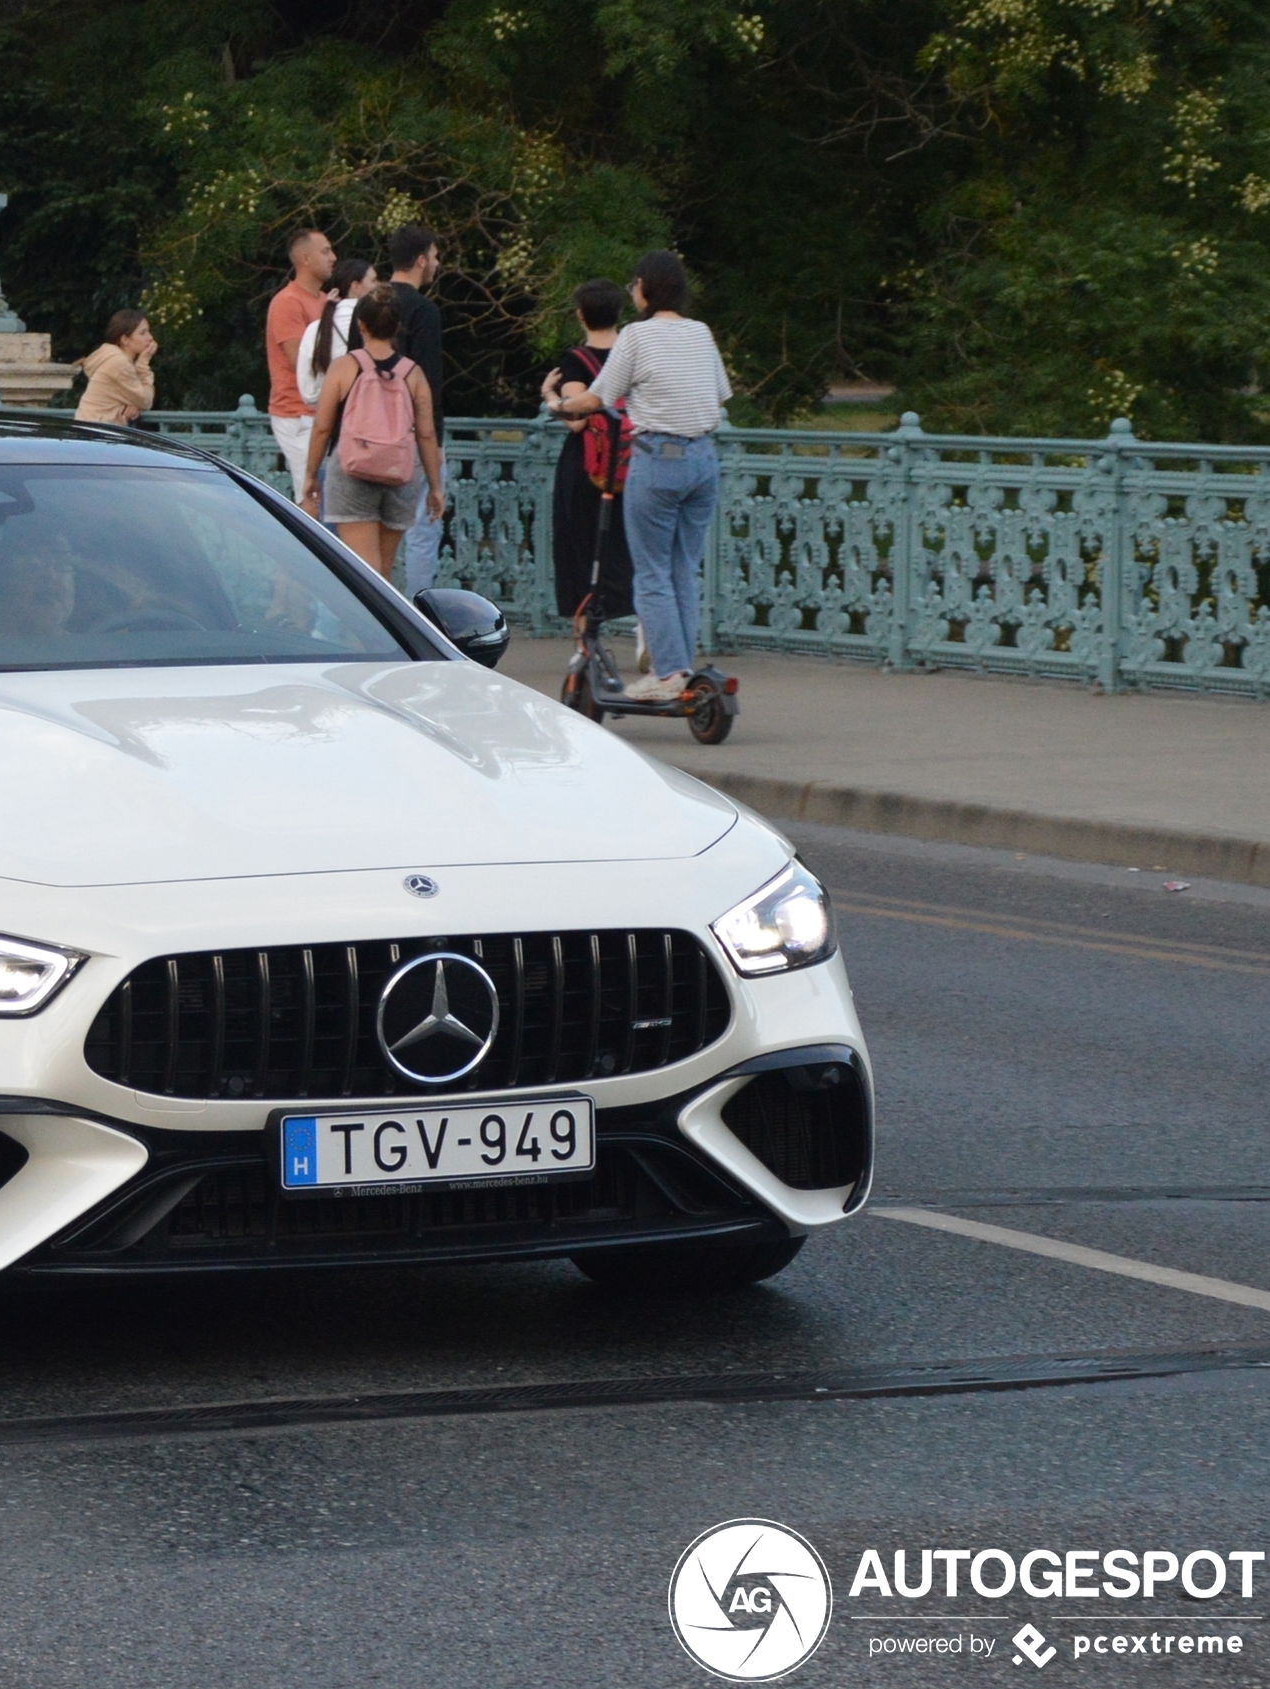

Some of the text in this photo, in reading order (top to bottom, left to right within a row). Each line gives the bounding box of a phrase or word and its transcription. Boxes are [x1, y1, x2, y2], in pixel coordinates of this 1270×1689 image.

[293, 1109, 576, 1175] H TGV-949
[351, 1183, 423, 1197] Mercedes-Benz
[449, 1175, 548, 1190] www.mercedes-benz.hu
